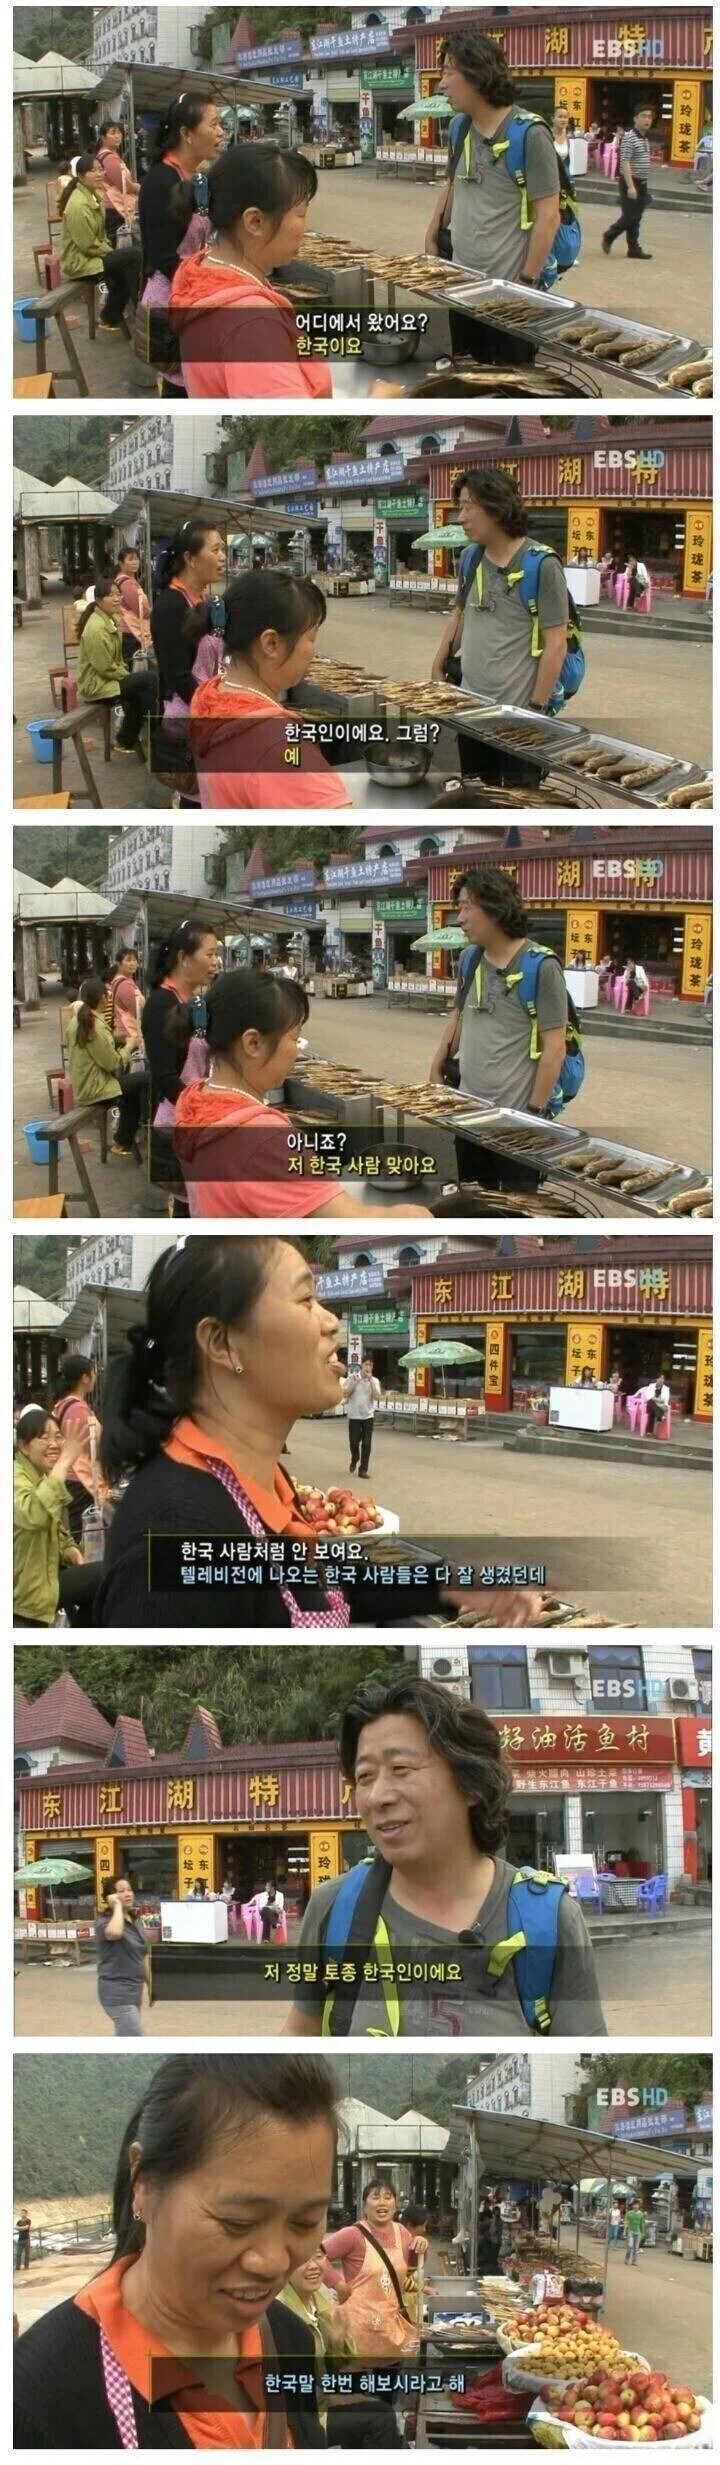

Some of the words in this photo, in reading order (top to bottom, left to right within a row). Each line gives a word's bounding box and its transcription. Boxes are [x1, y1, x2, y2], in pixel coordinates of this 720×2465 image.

[679, 104, 693, 153] 玲珑茶
[691, 534, 705, 583] 玲珑茶
[689, 938, 704, 988] 玲珑茶
[488, 1343, 500, 1387] 四件宝
